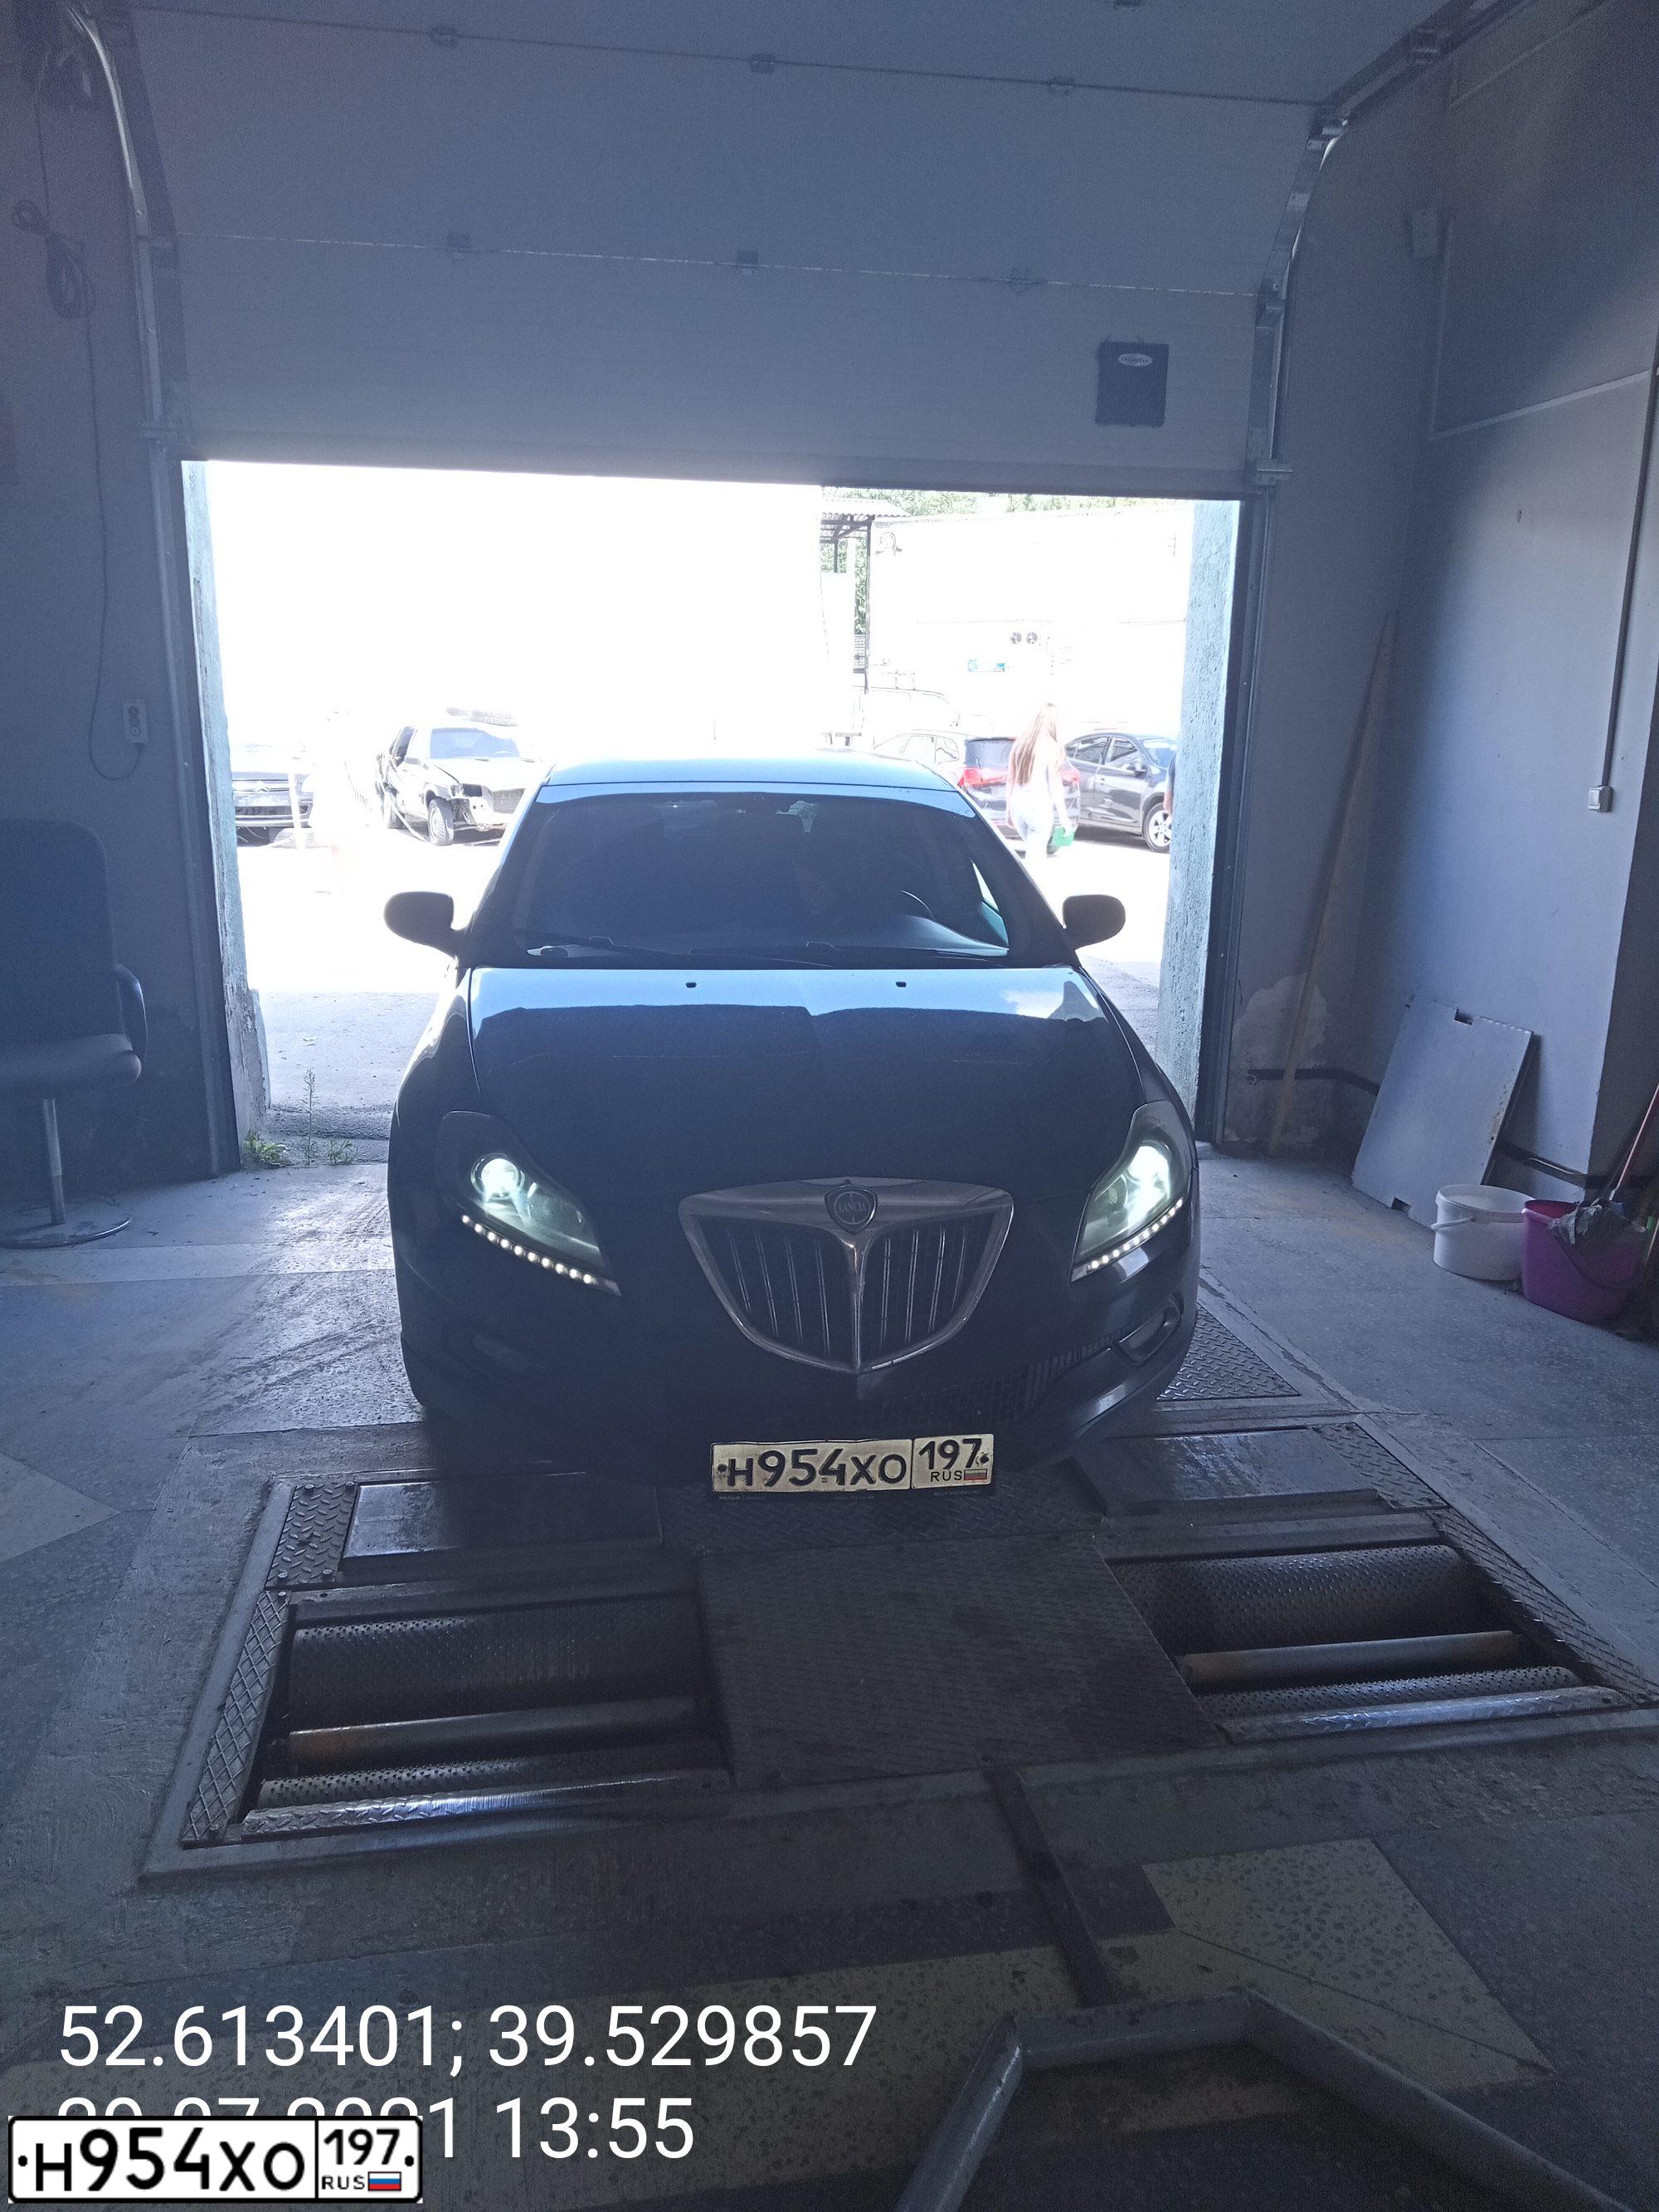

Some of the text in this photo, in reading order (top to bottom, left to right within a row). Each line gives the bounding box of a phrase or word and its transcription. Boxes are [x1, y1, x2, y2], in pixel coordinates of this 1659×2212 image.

[727, 1438, 982, 1488] Н954ХО 197
[930, 1470, 963, 1483] RUS
